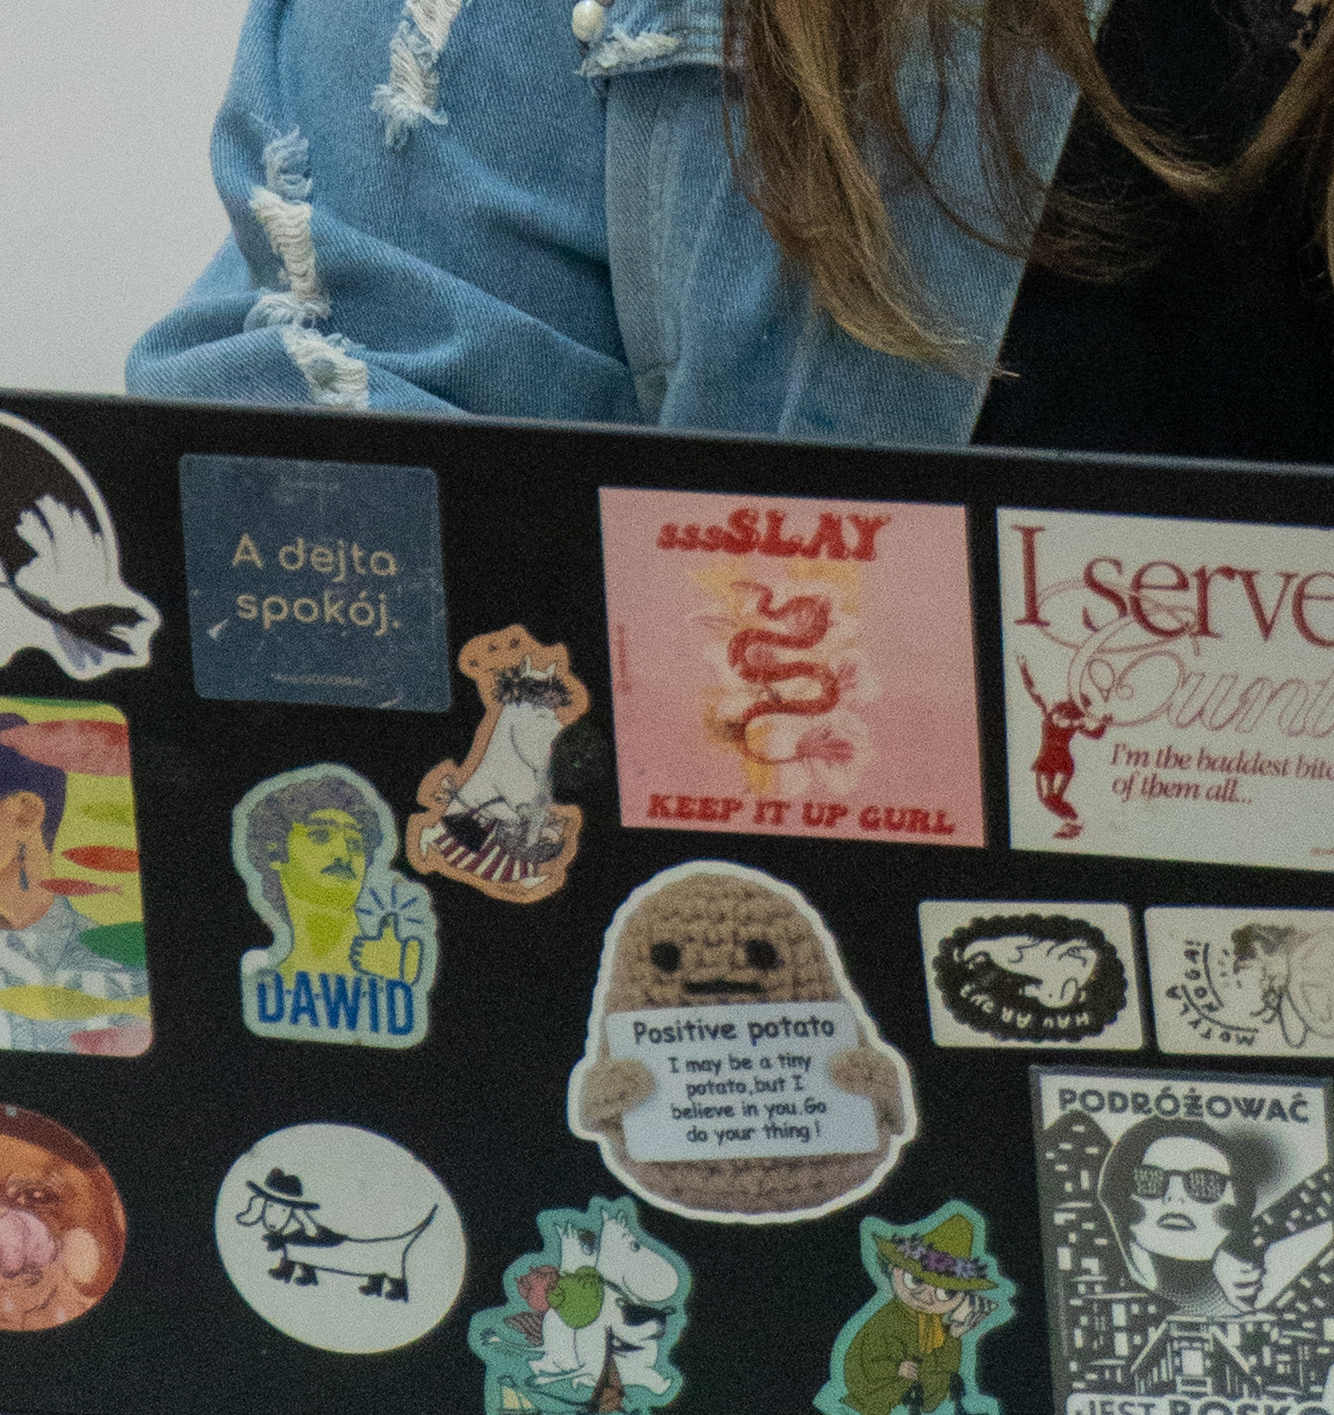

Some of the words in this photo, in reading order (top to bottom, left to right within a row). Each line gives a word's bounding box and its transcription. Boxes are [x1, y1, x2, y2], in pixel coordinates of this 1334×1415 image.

[231, 532, 264, 569] A
[278, 537, 398, 583] dejta
[1011, 524, 1051, 628] I
[236, 589, 401, 638] spokój.
[1110, 742, 1151, 768] I'm
[1155, 744, 1193, 771] the
[1196, 746, 1291, 777] baddest
[1111, 769, 1140, 804] of
[1140, 772, 1202, 801] them
[645, 792, 745, 823] KEEP
[752, 797, 792, 827] IT
[800, 798, 850, 829] UP
[858, 804, 957, 837] GURL
[255, 969, 415, 1037] DAWID
[632, 1018, 738, 1046] Positive
[746, 1014, 836, 1048] potato
[667, 1056, 680, 1074] I
[685, 1056, 723, 1077] may
[728, 1053, 754, 1071] be
[759, 1054, 773, 1071] a
[776, 1051, 813, 1073] tiny
[791, 1073, 805, 1093] I
[670, 1100, 736, 1121] believe
[741, 1100, 760, 1118] in
[1057, 1084, 1311, 1125] PODRÓŻOWAĆ
[685, 1124, 709, 1144] do
[715, 1125, 757, 1148] your
